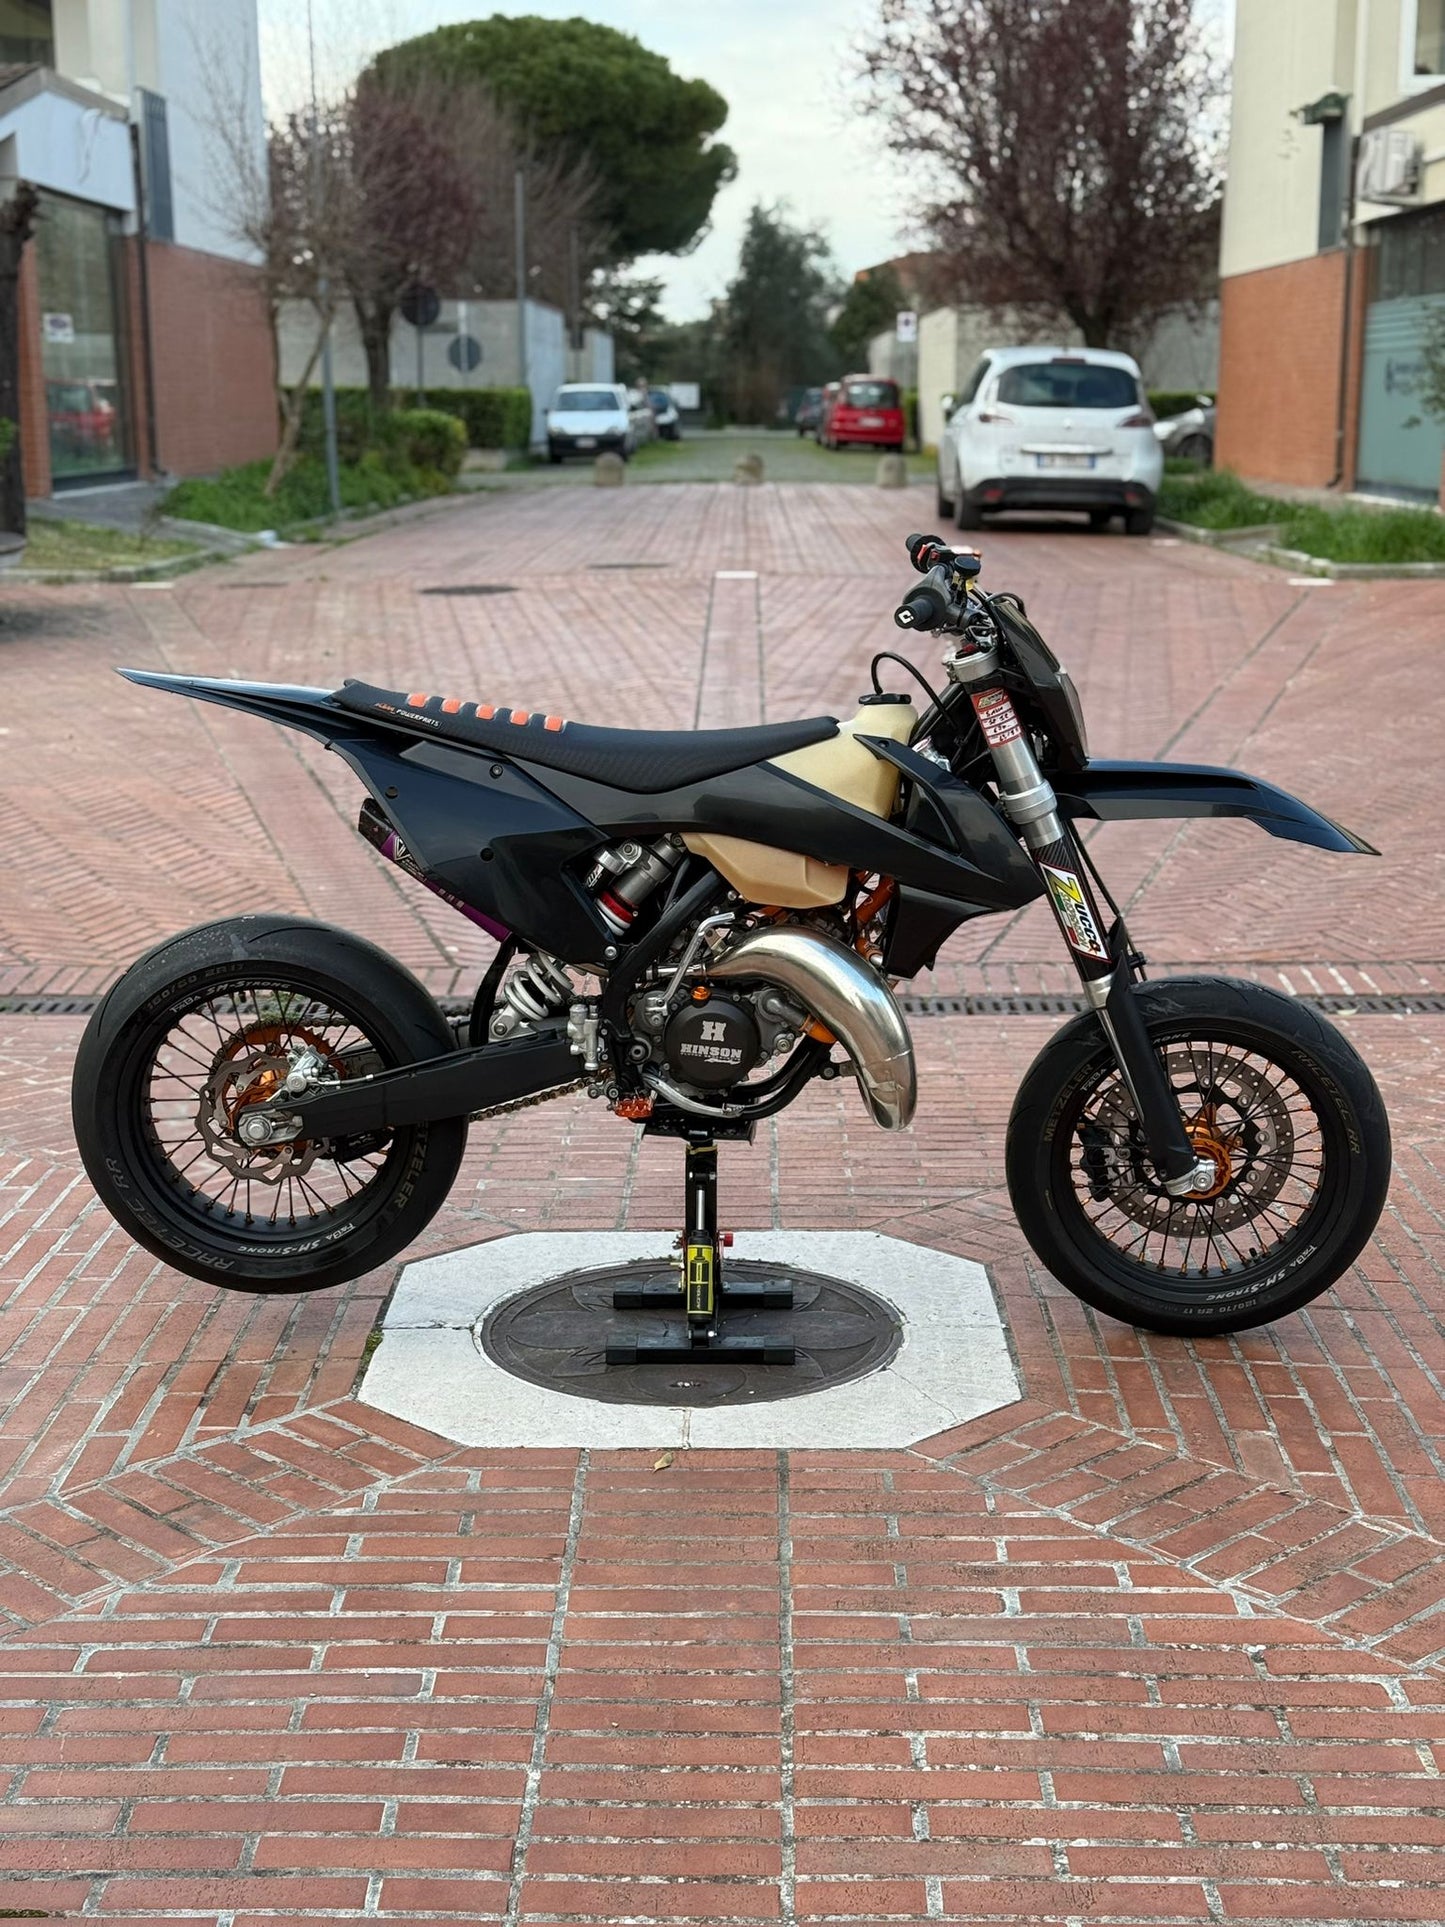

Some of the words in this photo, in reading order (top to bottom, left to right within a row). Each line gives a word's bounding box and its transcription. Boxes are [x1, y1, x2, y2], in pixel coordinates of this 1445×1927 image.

[680, 1042, 743, 1059] HINSON
[700, 1020, 727, 1042] H
[1043, 1063, 1094, 1142] METZELER
[1291, 1049, 1354, 1121] RACETEC
[1346, 1127, 1361, 1155] RR
[105, 1157, 130, 1189] RR
[393, 1119, 430, 1209] ETZELER
[126, 1197, 236, 1271] RACETEC
